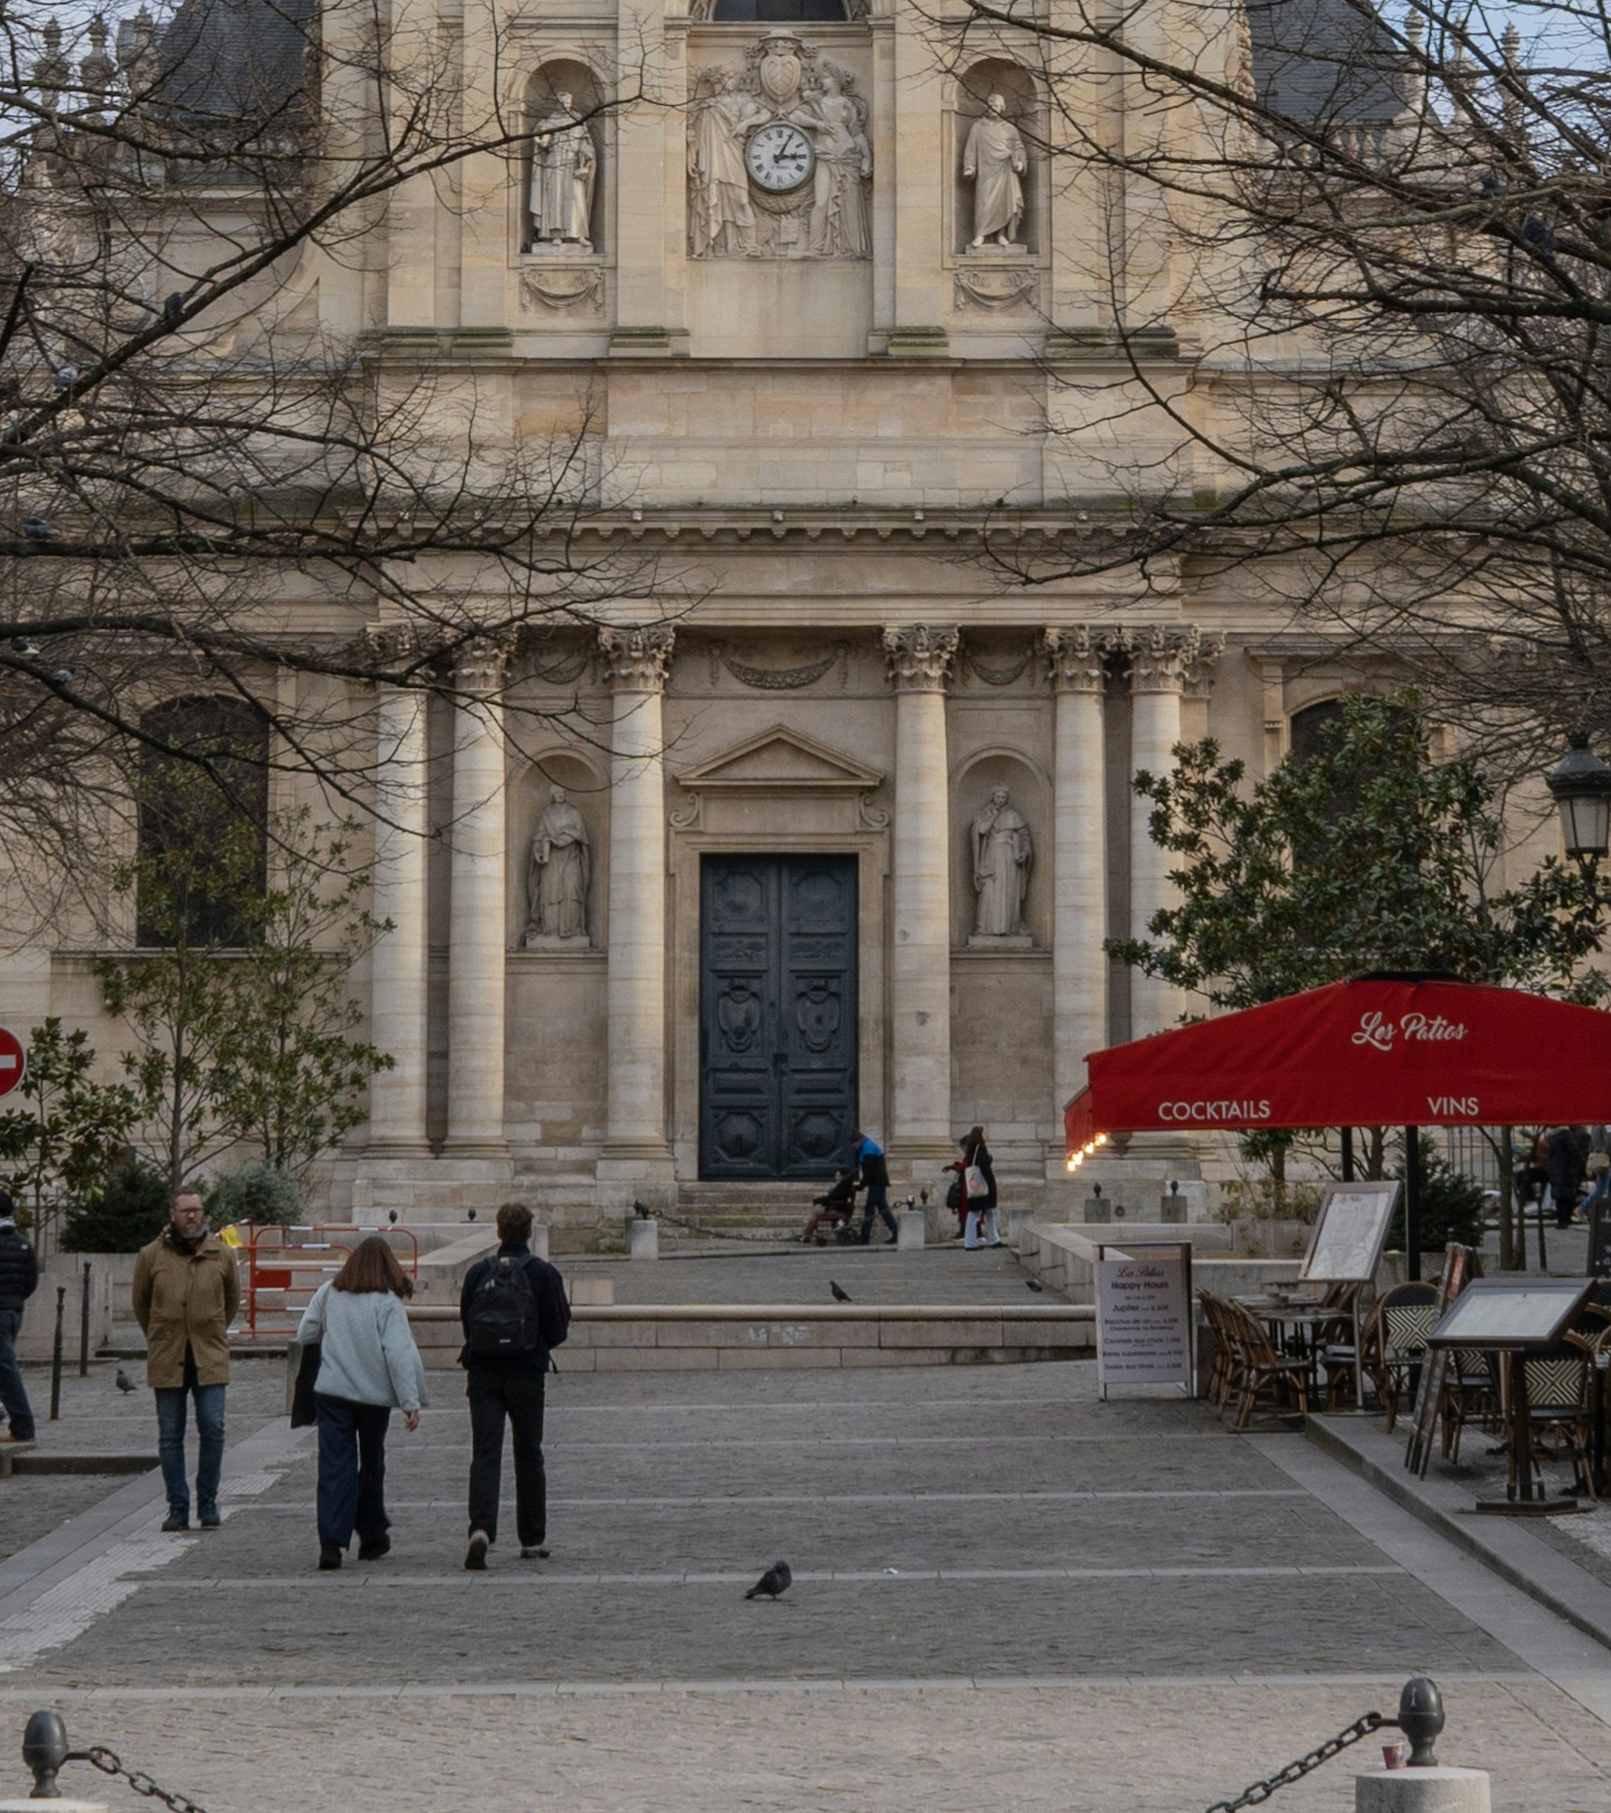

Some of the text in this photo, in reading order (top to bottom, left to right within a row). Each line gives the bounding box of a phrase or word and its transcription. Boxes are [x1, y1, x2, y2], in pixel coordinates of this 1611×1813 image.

[1351, 1011, 1468, 1051] Les Patios
[1158, 1099, 1270, 1120] COCKTAILS
[1427, 1096, 1479, 1117] VINS
[1111, 1281, 1141, 1290] Happy
